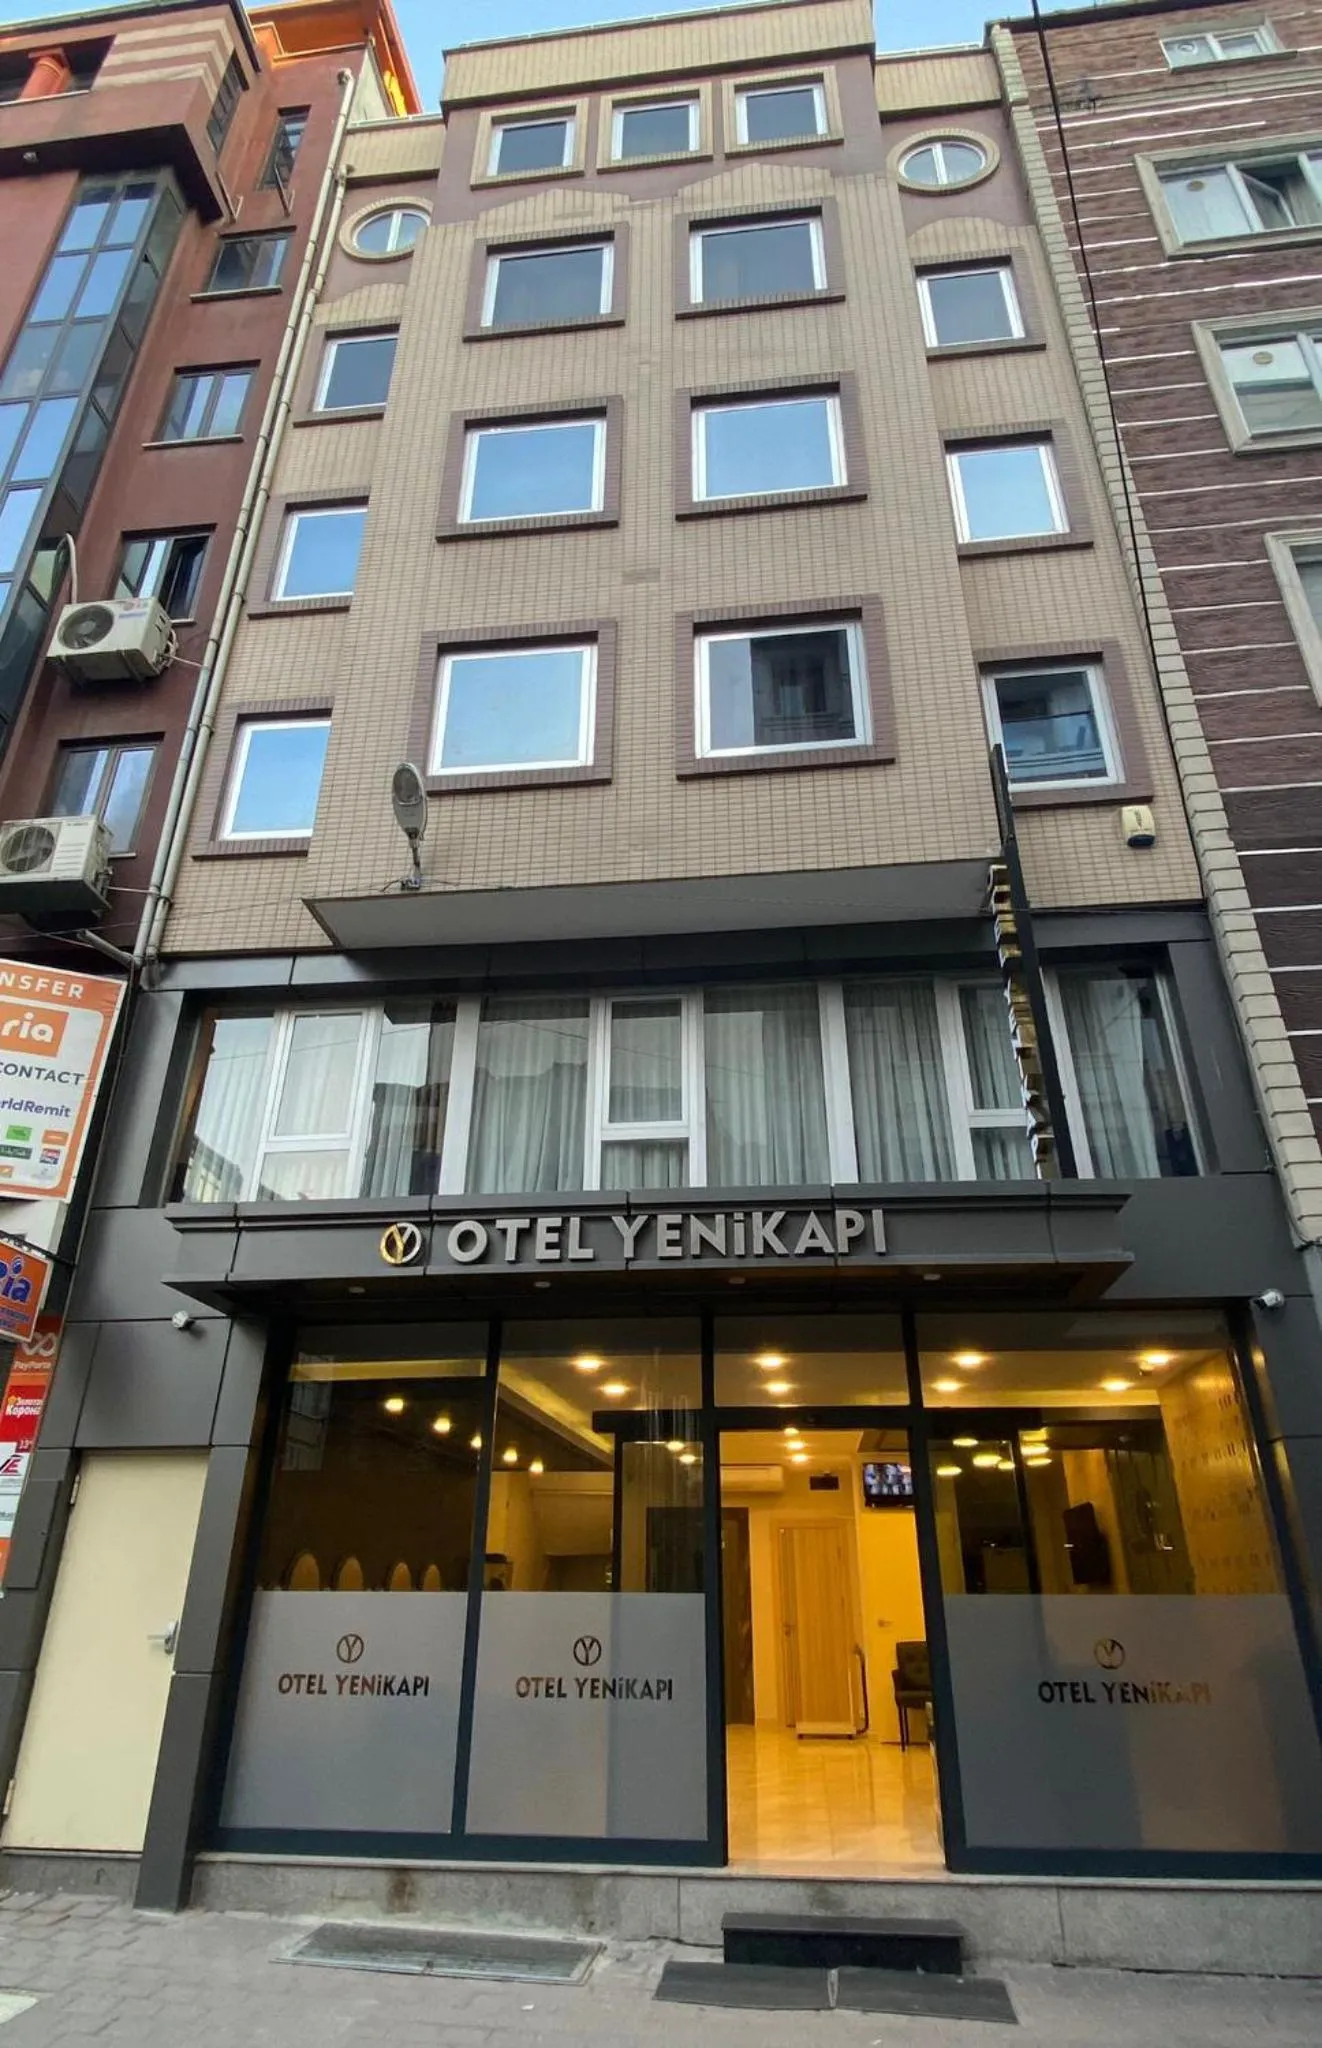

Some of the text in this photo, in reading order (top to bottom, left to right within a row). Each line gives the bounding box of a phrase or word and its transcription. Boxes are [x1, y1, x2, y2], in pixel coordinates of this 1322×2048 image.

[1, 1012, 54, 1043] ria
[446, 1216, 596, 1264] OTEL
[278, 1674, 327, 1696] OTEL
[515, 1676, 568, 1699] OTEL
[1037, 1681, 1096, 1704] OTEL
